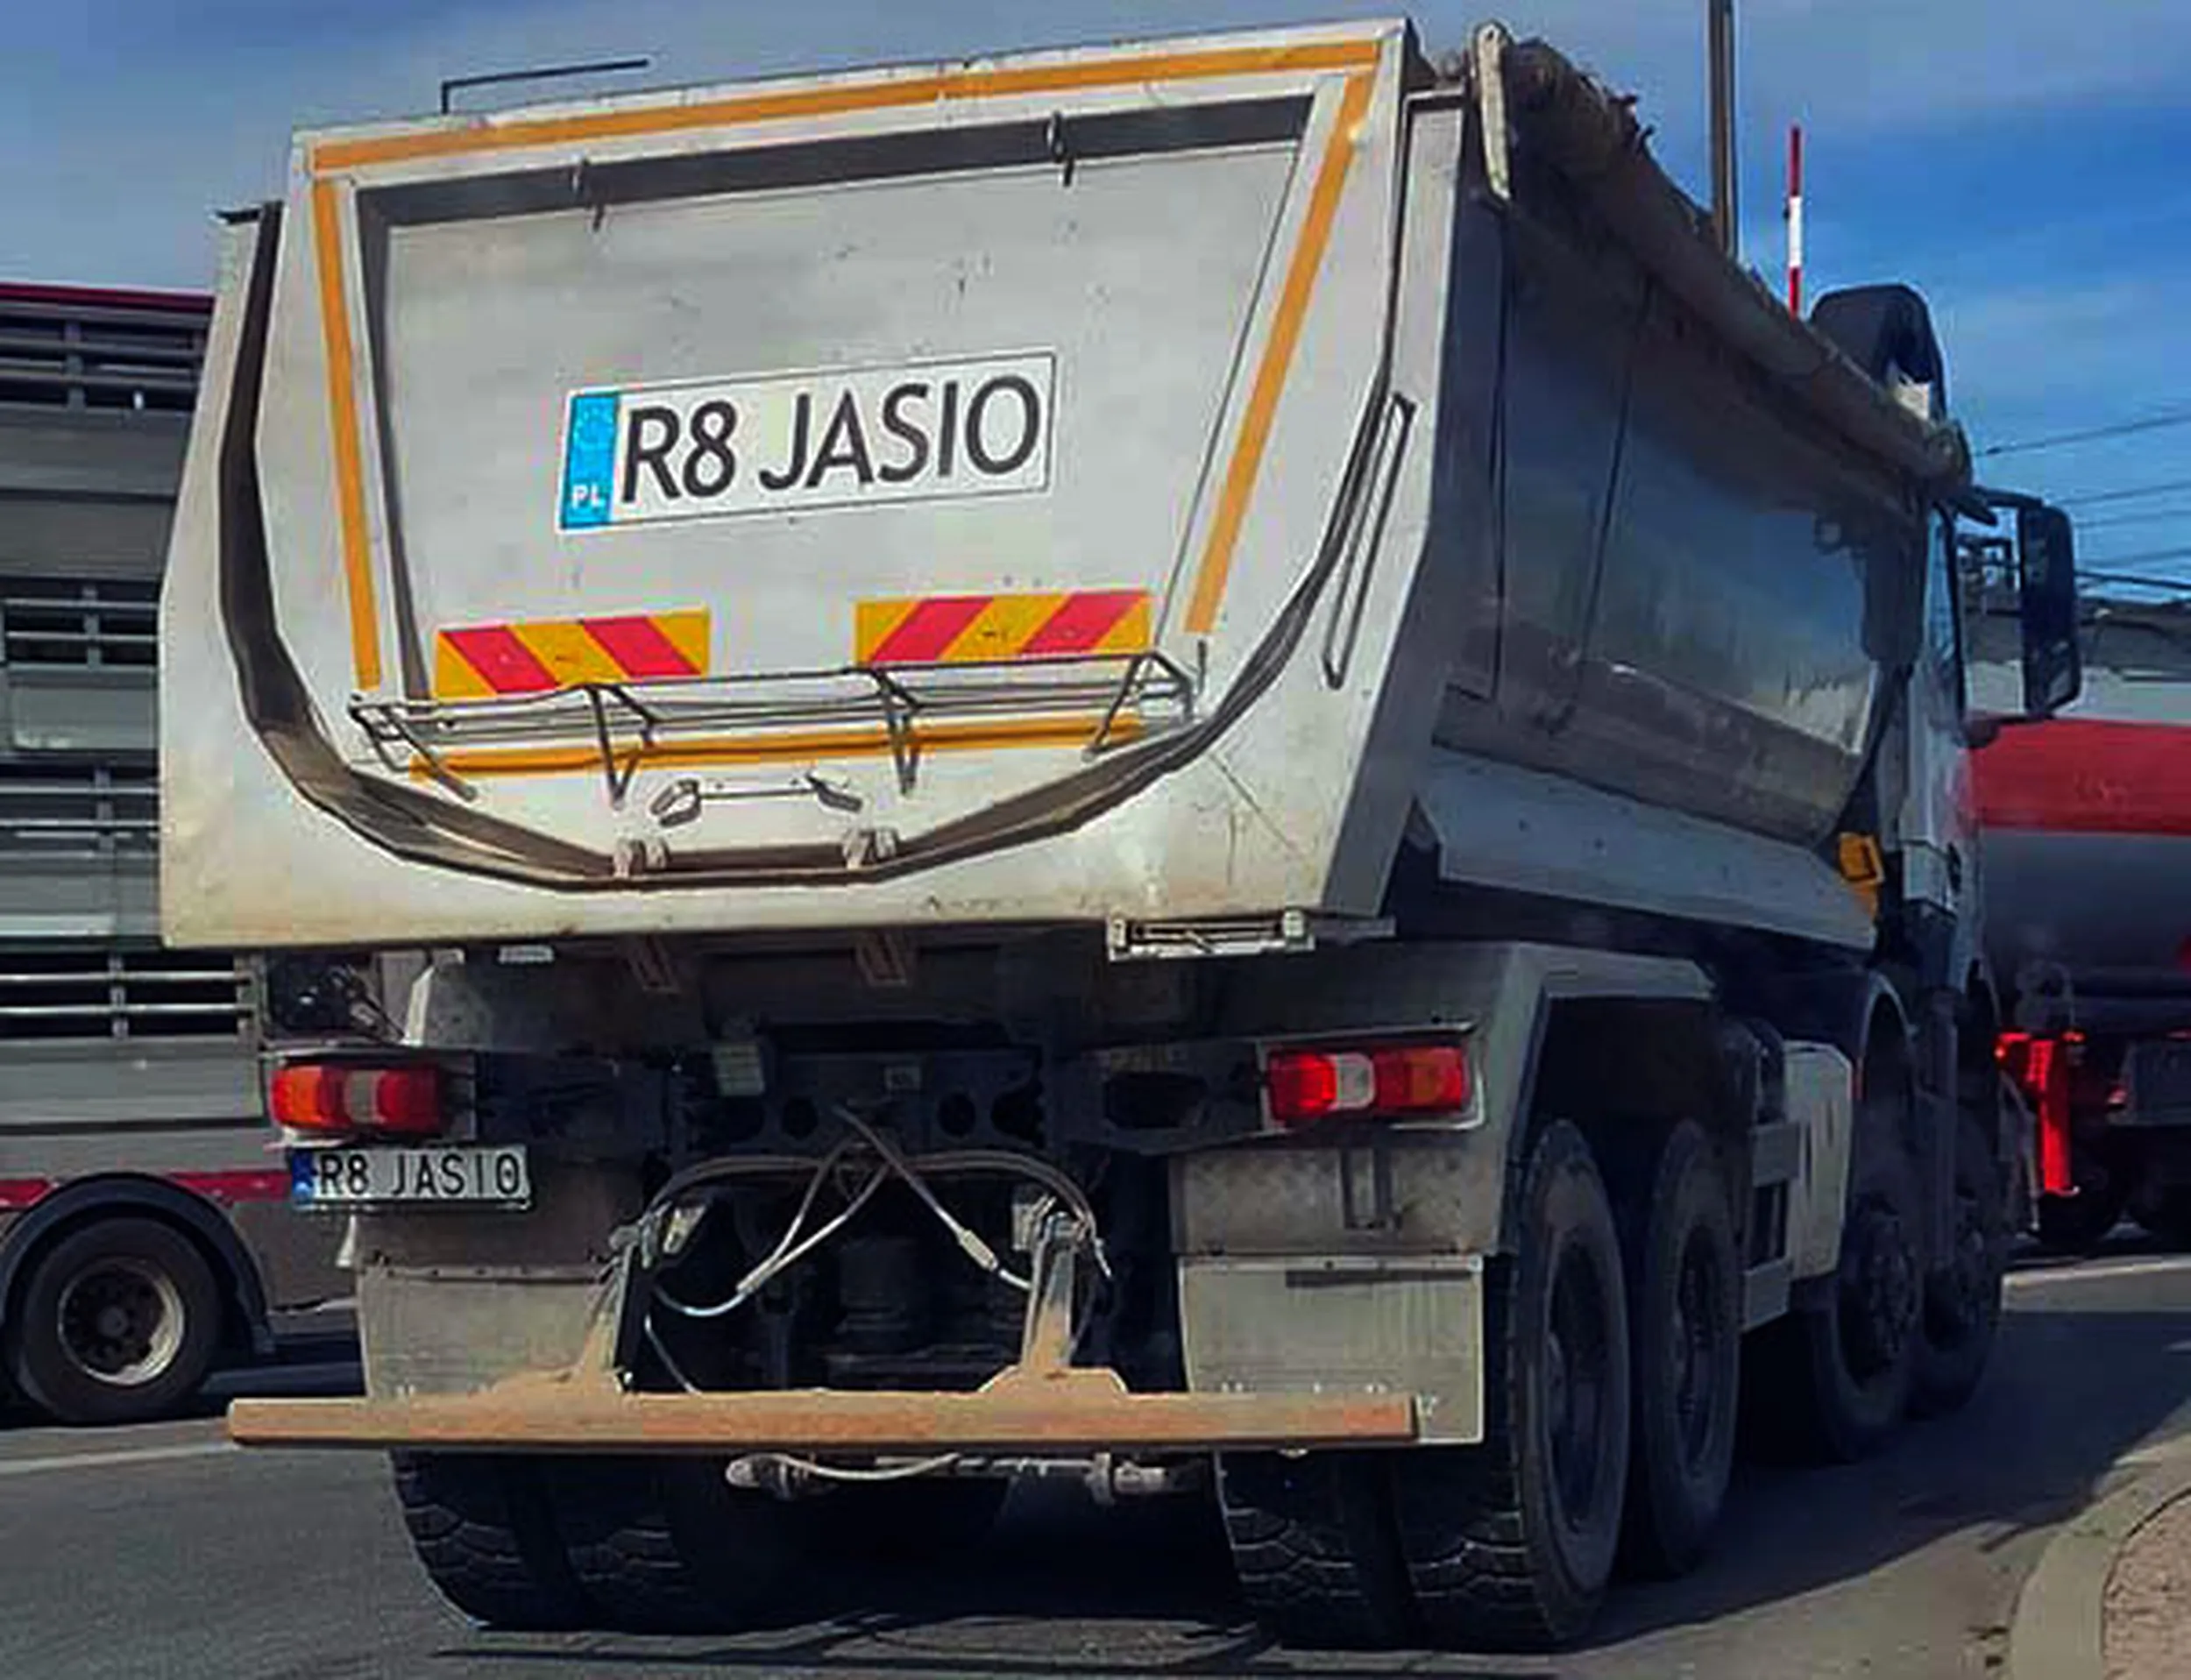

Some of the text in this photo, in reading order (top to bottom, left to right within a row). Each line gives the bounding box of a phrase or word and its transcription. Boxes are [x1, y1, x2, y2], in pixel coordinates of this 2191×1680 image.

[621, 375, 1040, 504] R8 JASIO
[571, 484, 605, 509] PL
[319, 1152, 521, 1195] R8 JASIO
